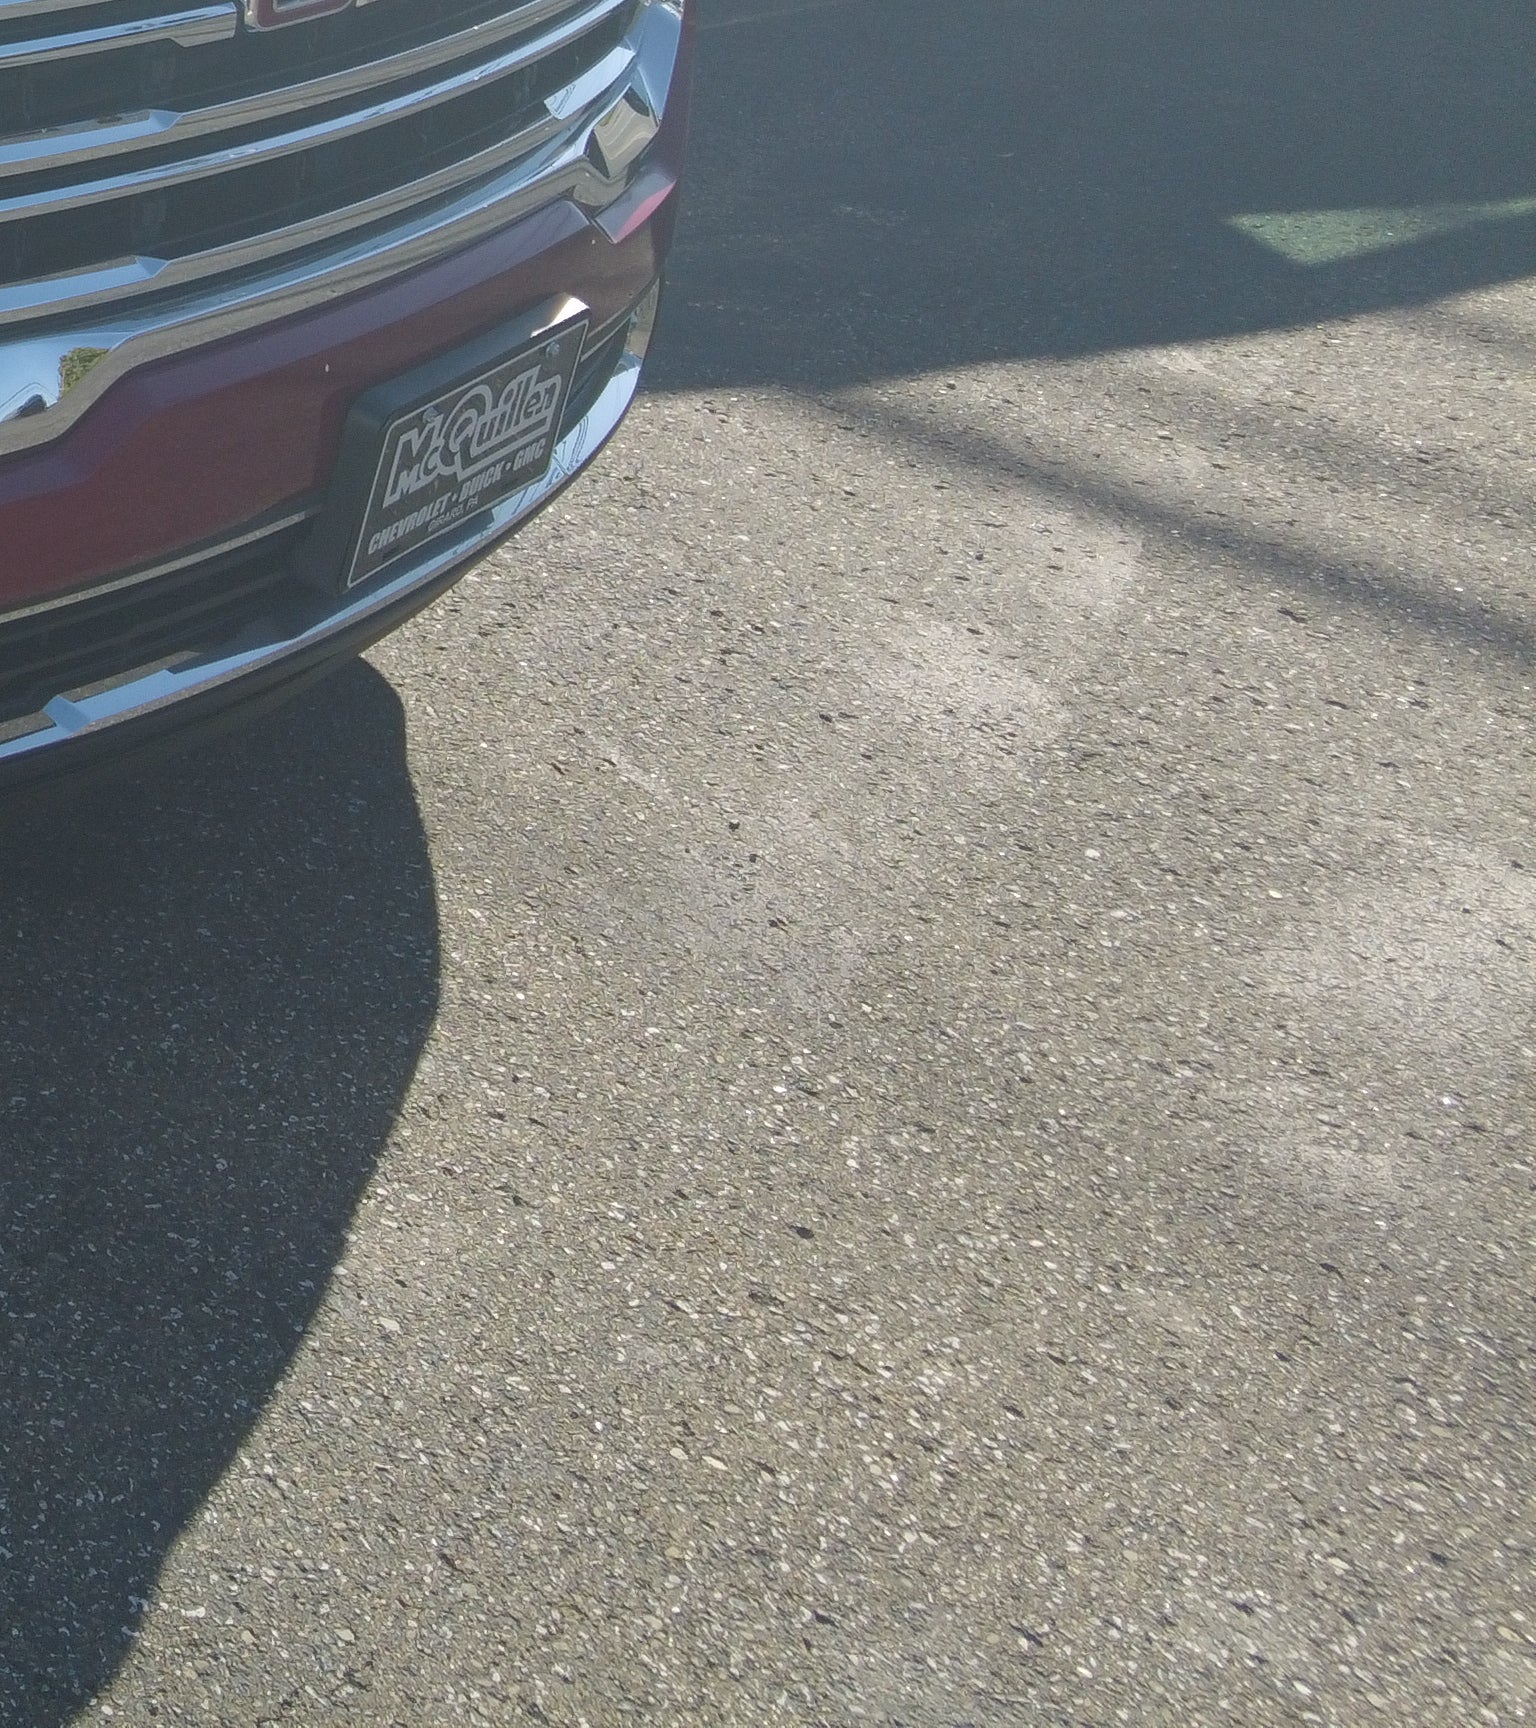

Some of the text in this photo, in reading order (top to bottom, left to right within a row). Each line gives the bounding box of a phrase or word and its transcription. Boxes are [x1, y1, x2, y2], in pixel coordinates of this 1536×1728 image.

[367, 438, 547, 555] CHEVROLET BUICK GMC
